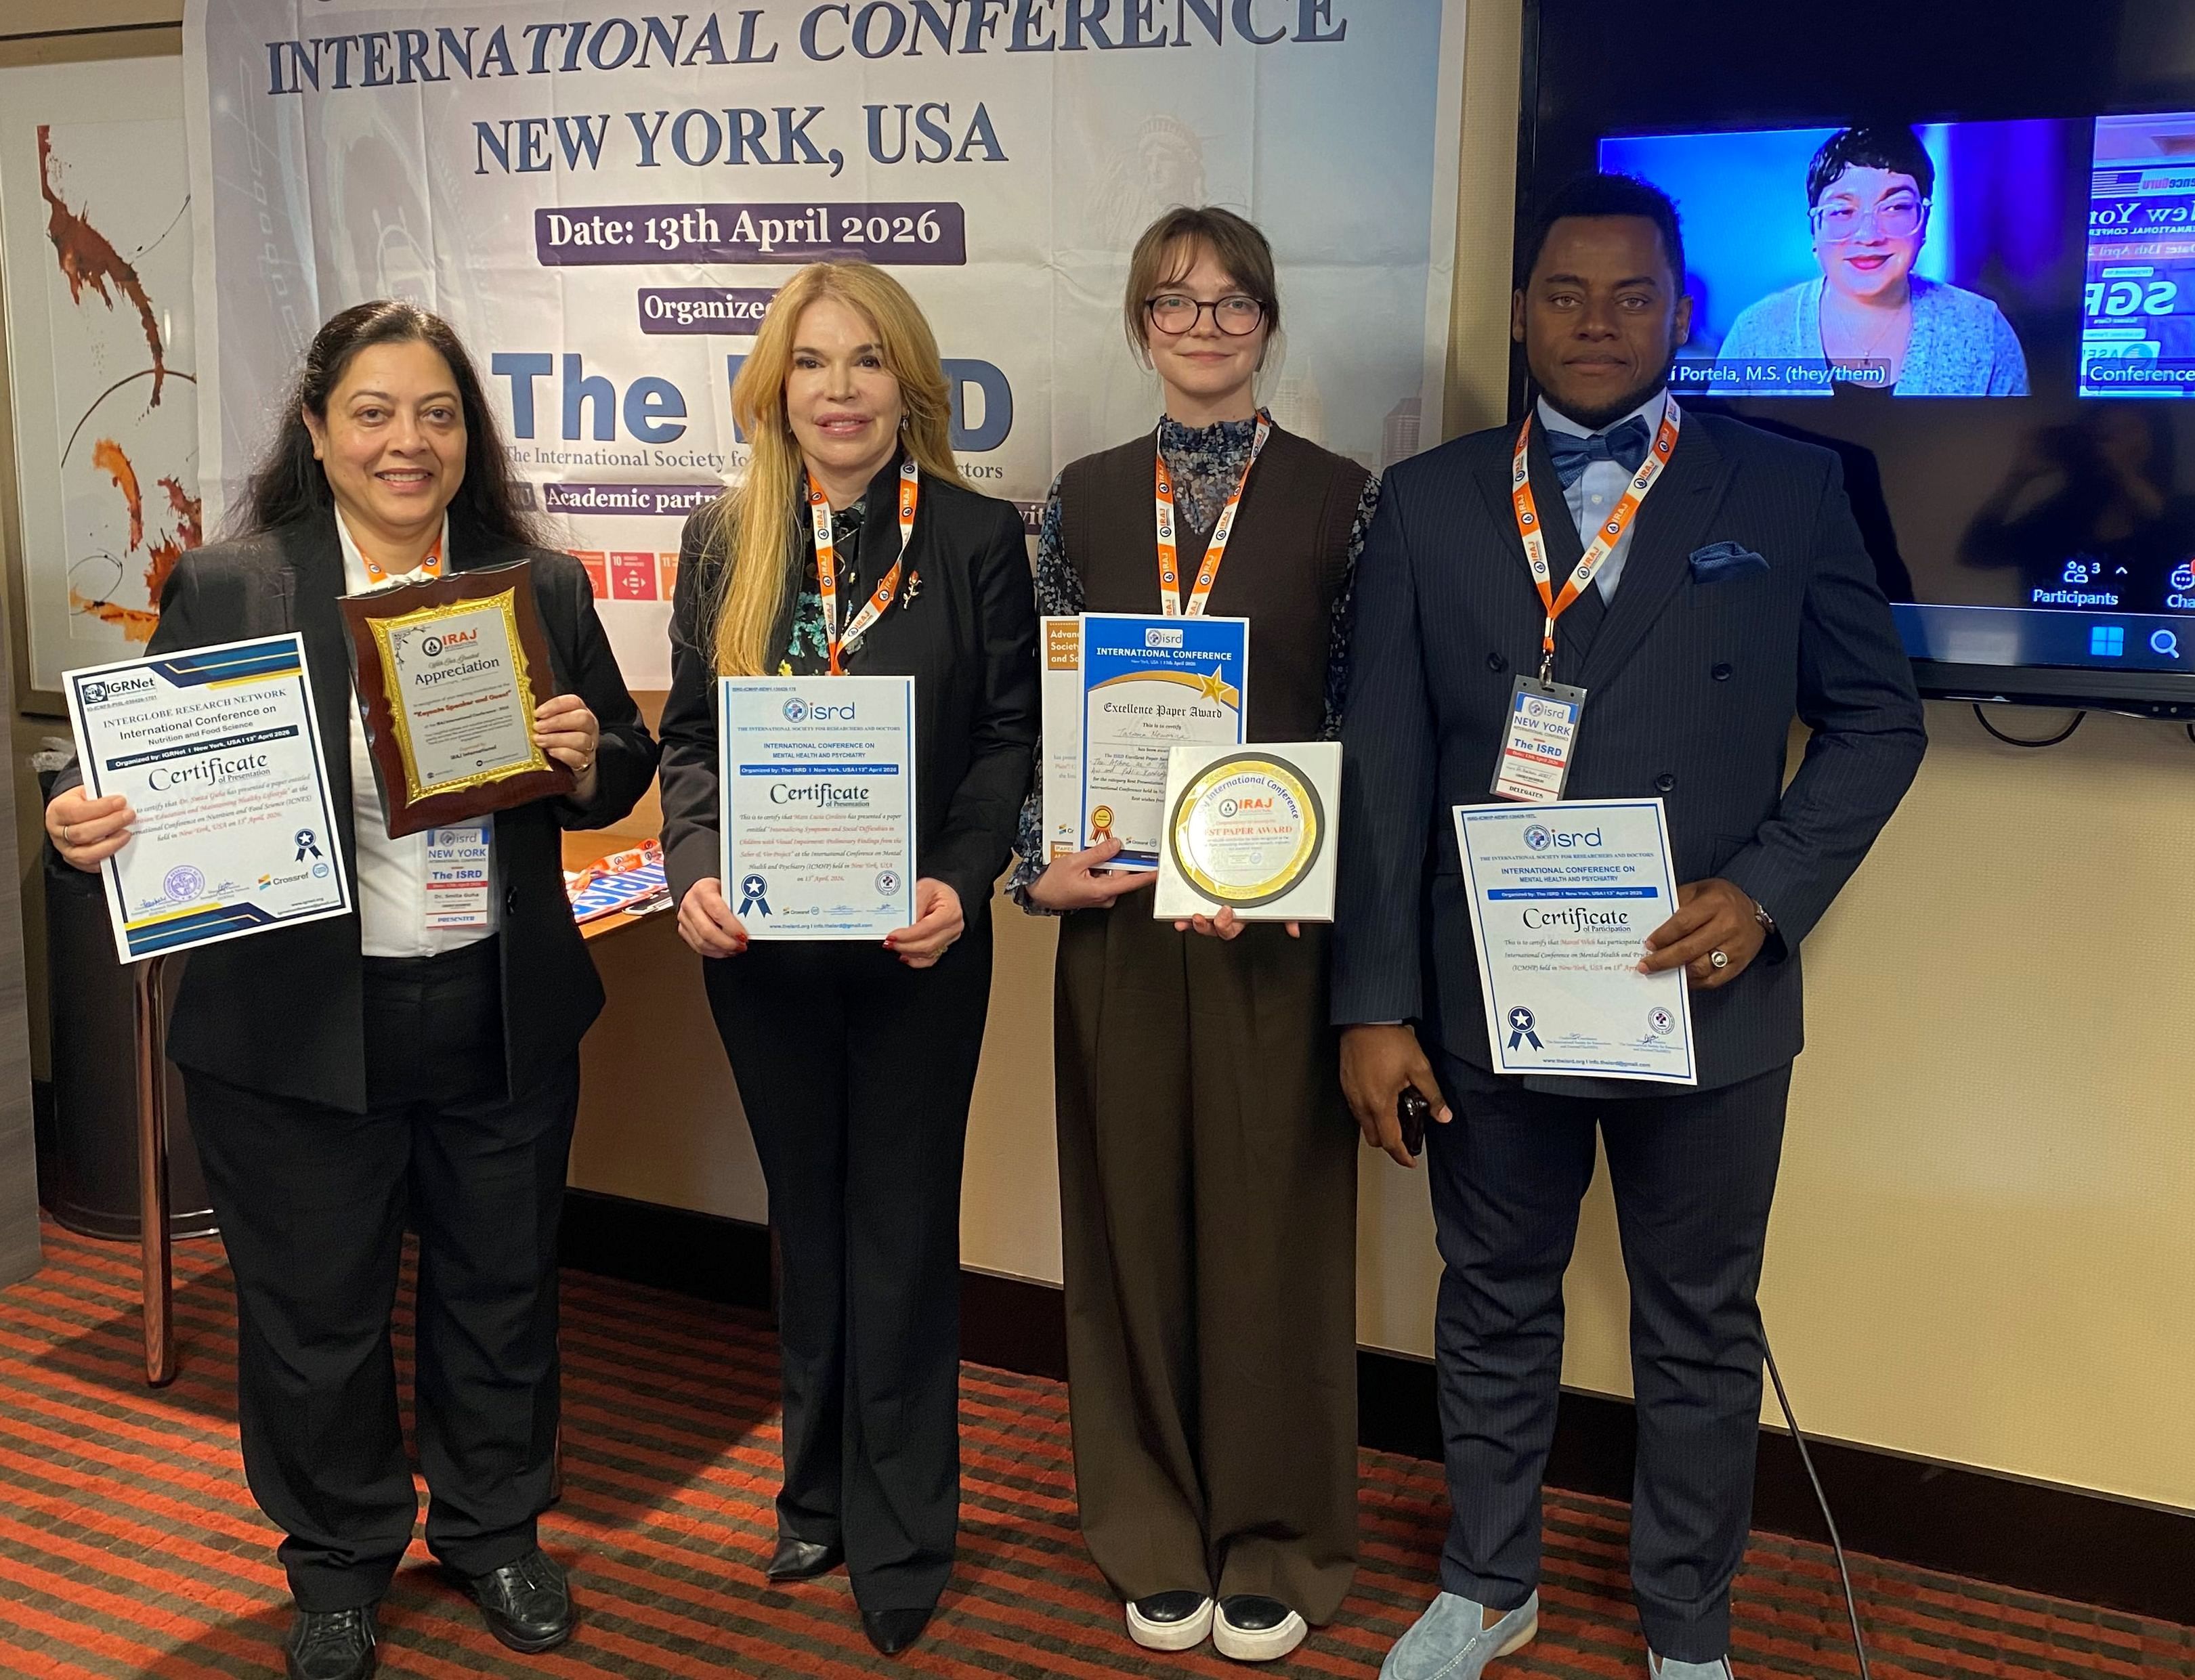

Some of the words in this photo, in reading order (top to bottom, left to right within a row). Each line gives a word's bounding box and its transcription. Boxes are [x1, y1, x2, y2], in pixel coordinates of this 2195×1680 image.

[265, 9, 778, 95] INTERNATIONAL
[800, 0, 1347, 62] CONFERENCE
[473, 114, 610, 175] NEW
[625, 105, 845, 178] YORK,
[863, 102, 1009, 164] USA
[547, 214, 633, 246] Date:
[645, 210, 720, 251] 13th
[729, 207, 832, 253] April
[842, 209, 941, 244] 2026
[1680, 365, 1740, 383] Portela,
[1745, 366, 1781, 381] M.S.
[1785, 366, 1886, 384] (they/them)
[492, 353, 687, 444] The
[536, 447, 648, 467] International
[655, 450, 725, 473] Society
[1641, 460, 1655, 479] IRAJ
[1159, 464, 1167, 484] IRAJ
[547, 488, 650, 509] Academic
[903, 488, 911, 508] IRAJ
[1219, 511, 1229, 531] IRAJ
[1613, 502, 1629, 524] IRAJ
[612, 556, 622, 566] 10
[662, 557, 670, 567] 11
[1202, 554, 1215, 574] IRAJ
[1584, 546, 1600, 569] IRAJ
[2091, 563, 2100, 574] 3
[884, 571, 897, 590] IRAJ
[2033, 589, 2119, 607] Participants
[854, 611, 870, 629] IRAJ
[442, 628, 477, 645] IRAJ
[1162, 633, 1182, 644] isrd
[1051, 654, 1067, 662] and
[1096, 647, 1171, 658] INTERNATIONAL
[1172, 650, 1232, 661] CONFERENCE
[415, 659, 500, 685] Appreciation
[106, 678, 154, 694] IGRNet
[104, 710, 170, 728] INTERGLOBE
[175, 698, 231, 715] RESEARCH
[234, 689, 286, 704] NETWORK
[445, 700, 474, 711] Speaker
[809, 702, 855, 720] isrd
[1103, 702, 1153, 714] Excellence
[1156, 704, 1187, 717] Paper
[1190, 706, 1222, 718] Award
[1544, 706, 1564, 719] isrd
[120, 719, 192, 740] International
[195, 709, 260, 726] Conference
[262, 706, 276, 714] on
[1514, 715, 1540, 729] NEW
[1543, 722, 1571, 736] YORK
[148, 735, 184, 746] Nutrition
[185, 731, 200, 739] and
[201, 727, 221, 735] Food
[221, 721, 253, 732] Science
[115, 756, 150, 767] Organized
[161, 748, 186, 758] IGRNet
[193, 744, 213, 752] New
[226, 739, 243, 748] USA
[257, 732, 276, 744] April
[273, 729, 292, 741] 2026
[1514, 738, 1533, 750] The
[1537, 744, 1562, 756] ISRD
[148, 752, 268, 792] Certificate
[218, 775, 226, 783] of
[228, 768, 270, 781] Presentation
[770, 783, 870, 808] Certificate
[1208, 776, 1265, 801] International
[1266, 779, 1299, 819] Conference
[1509, 785, 1543, 798] DELEGATES
[1239, 798, 1273, 809] IRAJ
[456, 834, 477, 844] isrd
[1223, 827, 1254, 836] PAPER
[1258, 826, 1293, 836] AWARD
[1551, 827, 1602, 847] isrd
[428, 850, 454, 859] NEW
[457, 848, 486, 857] YORK
[273, 871, 309, 886] Crossref
[432, 871, 453, 880] The
[456, 869, 482, 879] ISRD
[1523, 907, 1629, 933] Certificate
[1592, 925, 1631, 933] Participation
